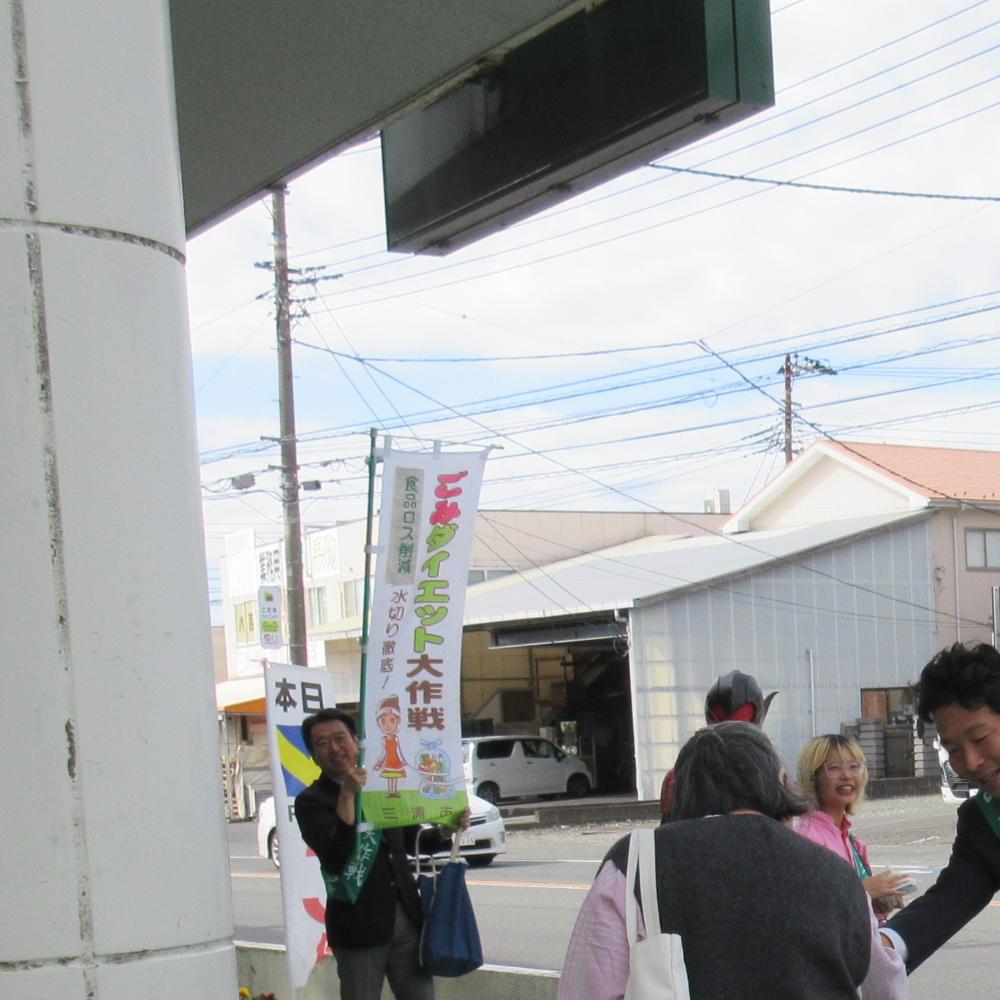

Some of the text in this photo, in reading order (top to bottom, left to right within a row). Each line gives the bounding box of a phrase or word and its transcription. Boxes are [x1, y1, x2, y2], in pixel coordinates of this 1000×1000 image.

[397, 476, 419, 574] 食品ロス削減
[405, 470, 468, 731] ごみダイエット大作戦
[274, 677, 325, 714] 本日
